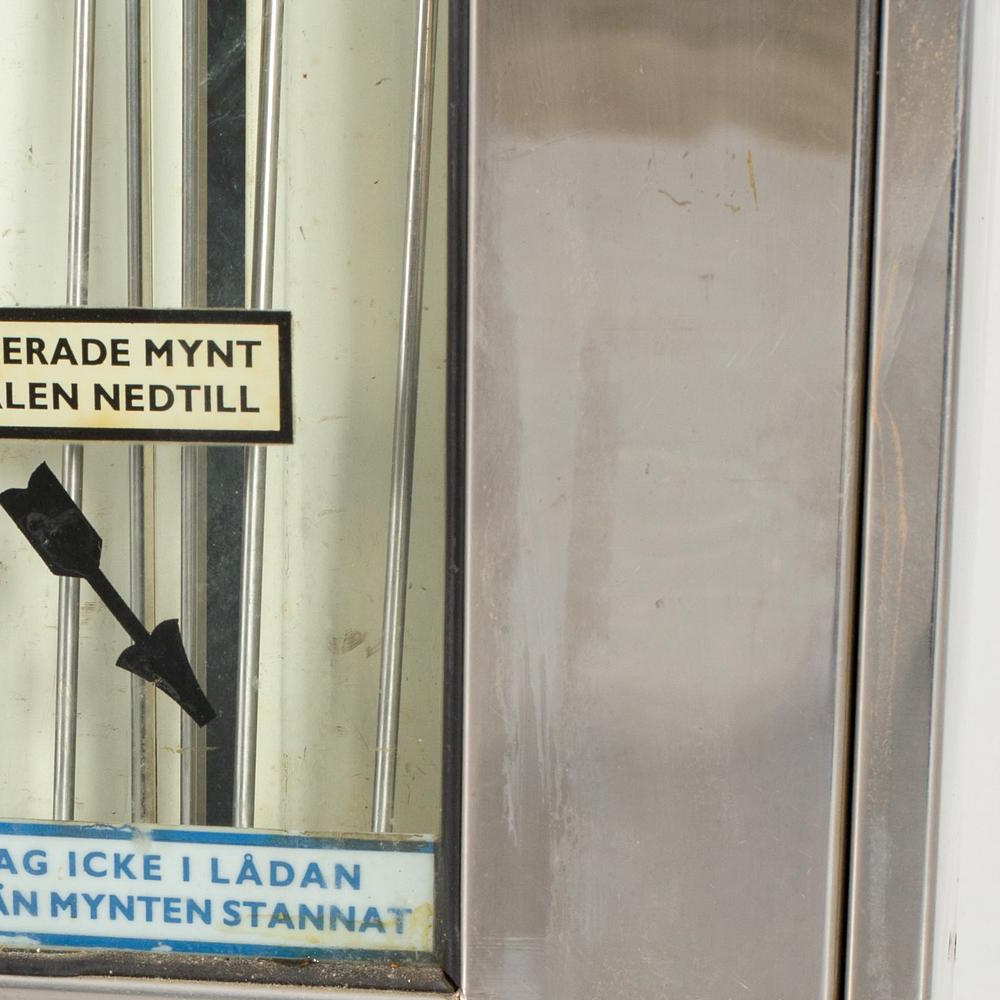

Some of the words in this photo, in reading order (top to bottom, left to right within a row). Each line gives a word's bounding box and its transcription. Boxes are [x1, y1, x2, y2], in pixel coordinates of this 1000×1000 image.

[145, 339, 262, 368] MYNT
[94, 384, 260, 413] NEDTILL
[69, 851, 161, 881] ICKE
[183, 854, 190, 882] I
[211, 853, 360, 890] LÅDAN
[51, 893, 212, 925] MYNTEN
[223, 902, 412, 934] STANNAT
